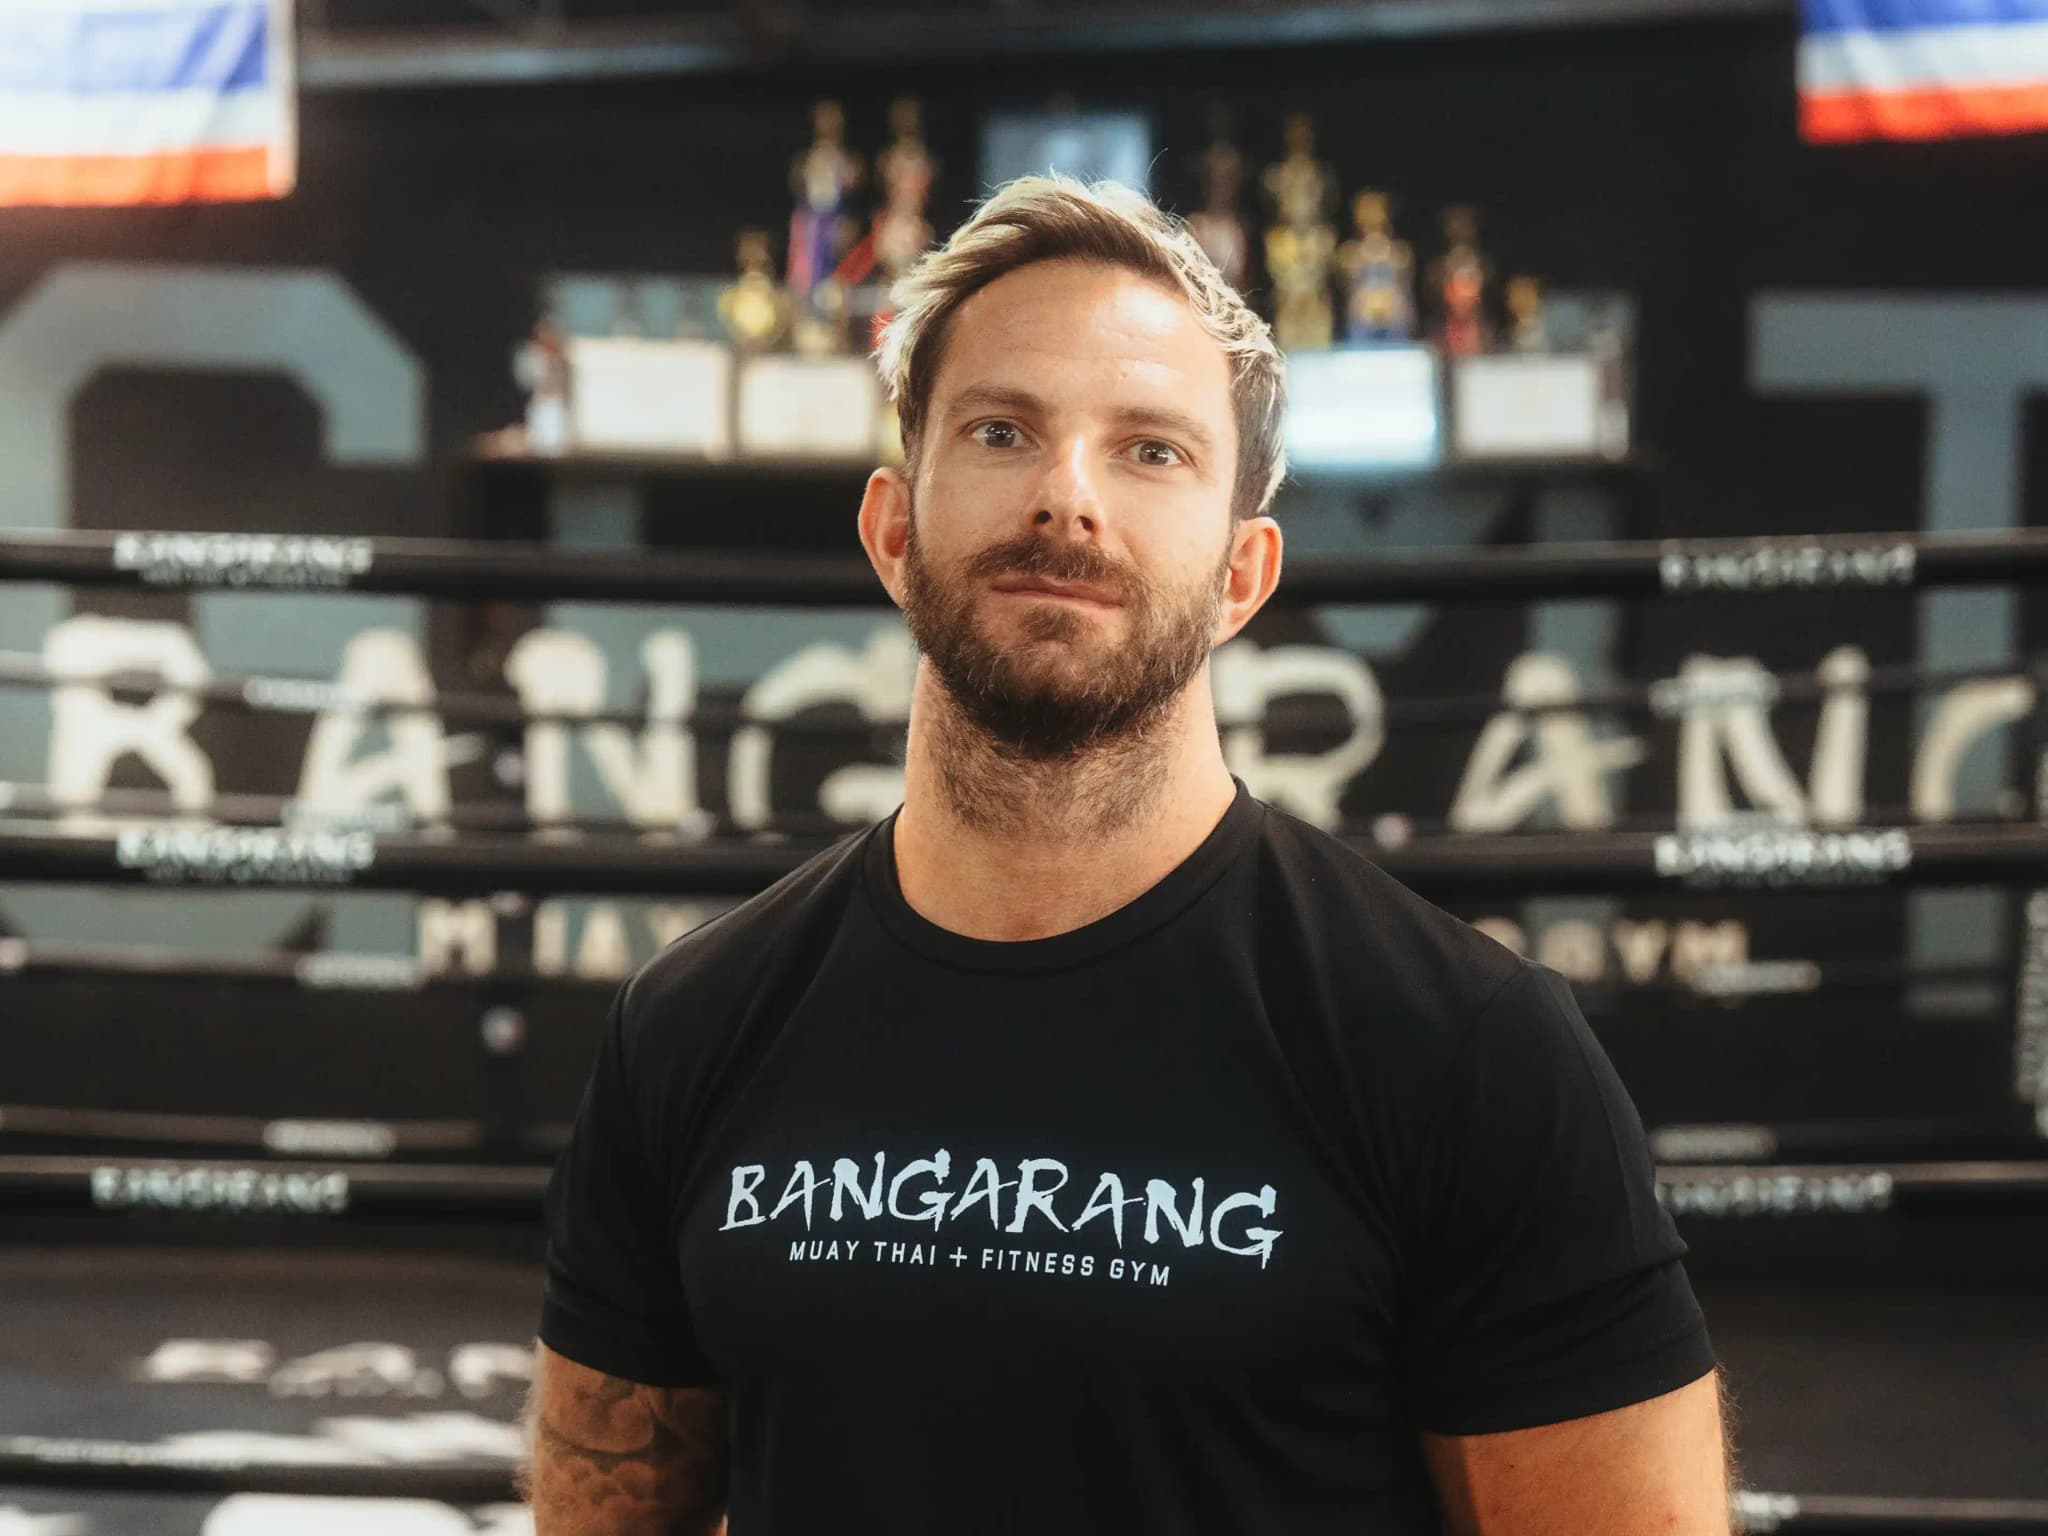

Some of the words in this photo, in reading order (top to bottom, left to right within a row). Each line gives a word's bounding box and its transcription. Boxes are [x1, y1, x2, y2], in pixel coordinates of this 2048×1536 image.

[44, 612, 2038, 834] BANGRAN
[719, 1148, 1284, 1270] BANGARANG
[788, 1239, 860, 1261] MUAY
[873, 1240, 936, 1266] THAI
[981, 1248, 1095, 1277] FITNESS
[1109, 1258, 1170, 1287] GYM
